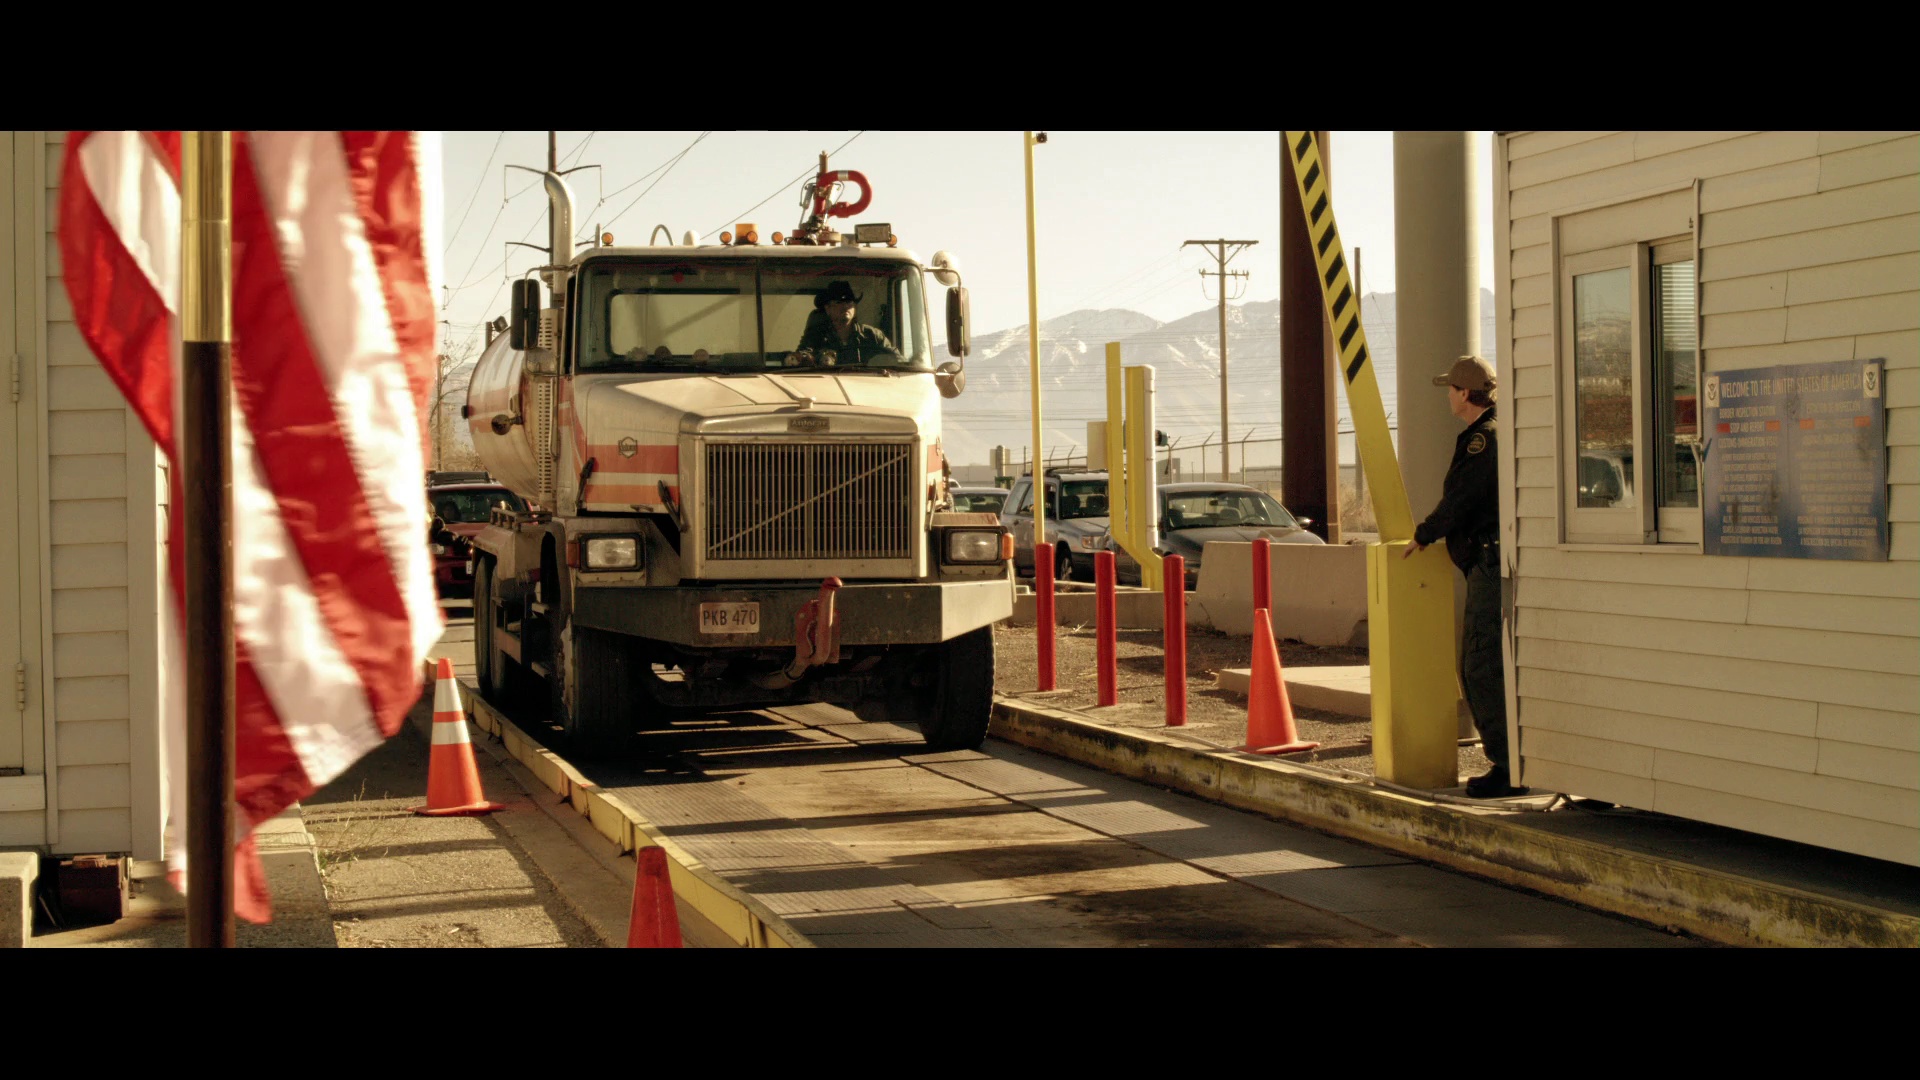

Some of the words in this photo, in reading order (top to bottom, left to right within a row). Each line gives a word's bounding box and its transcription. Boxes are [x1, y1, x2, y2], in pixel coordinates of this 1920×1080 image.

[1721, 381, 1750, 398] WELCOME
[1751, 380, 1759, 397] TO
[1760, 379, 1771, 395] THE
[1773, 378, 1794, 394] UNITED
[1797, 376, 1820, 392] STATES
[1821, 375, 1829, 392] OF
[1831, 373, 1862, 390] AMERICA
[703, 610, 728, 626] PKB
[731, 609, 757, 626] 470
